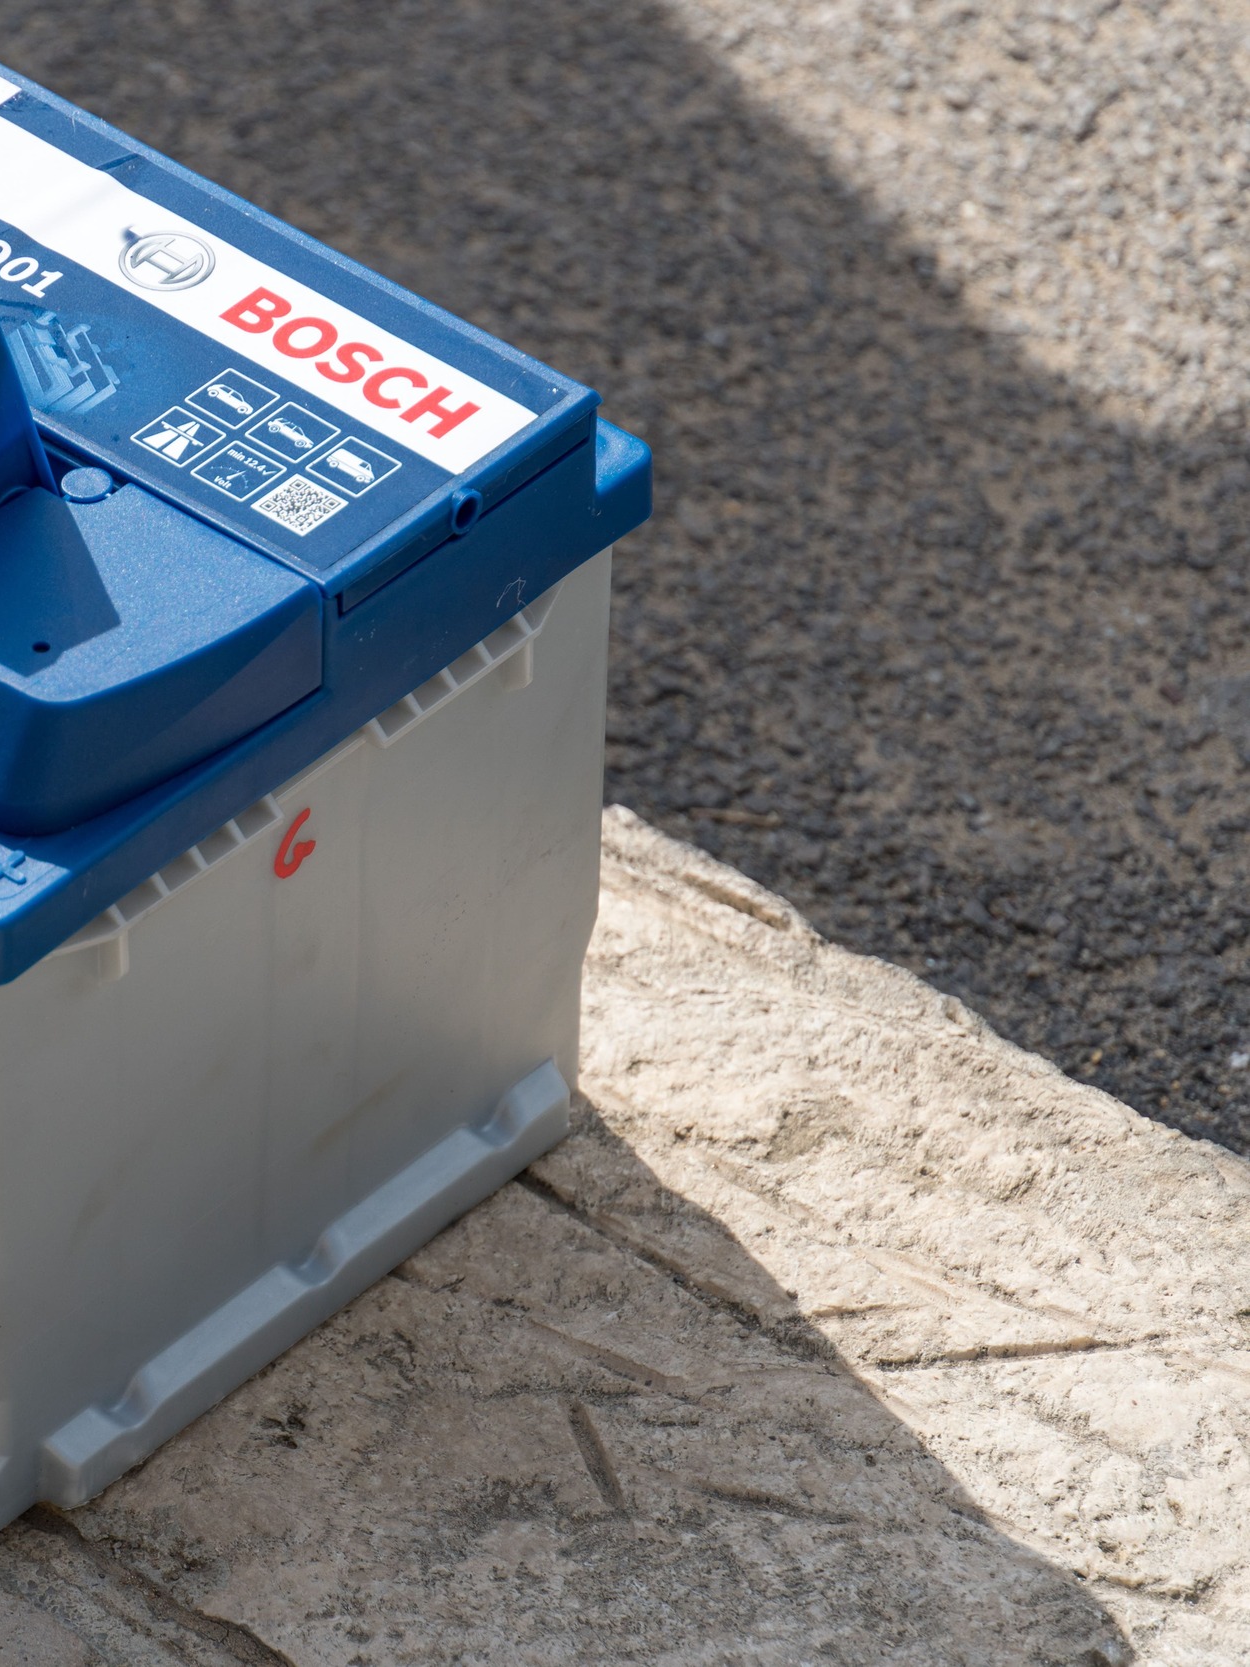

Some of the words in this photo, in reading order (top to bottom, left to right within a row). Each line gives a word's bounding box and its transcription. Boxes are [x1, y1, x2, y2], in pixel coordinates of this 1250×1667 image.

[218, 286, 482, 440] BOSCH
[227, 448, 246, 462] min
[243, 456, 267, 473] 12.4
[214, 475, 232, 490] Volt
